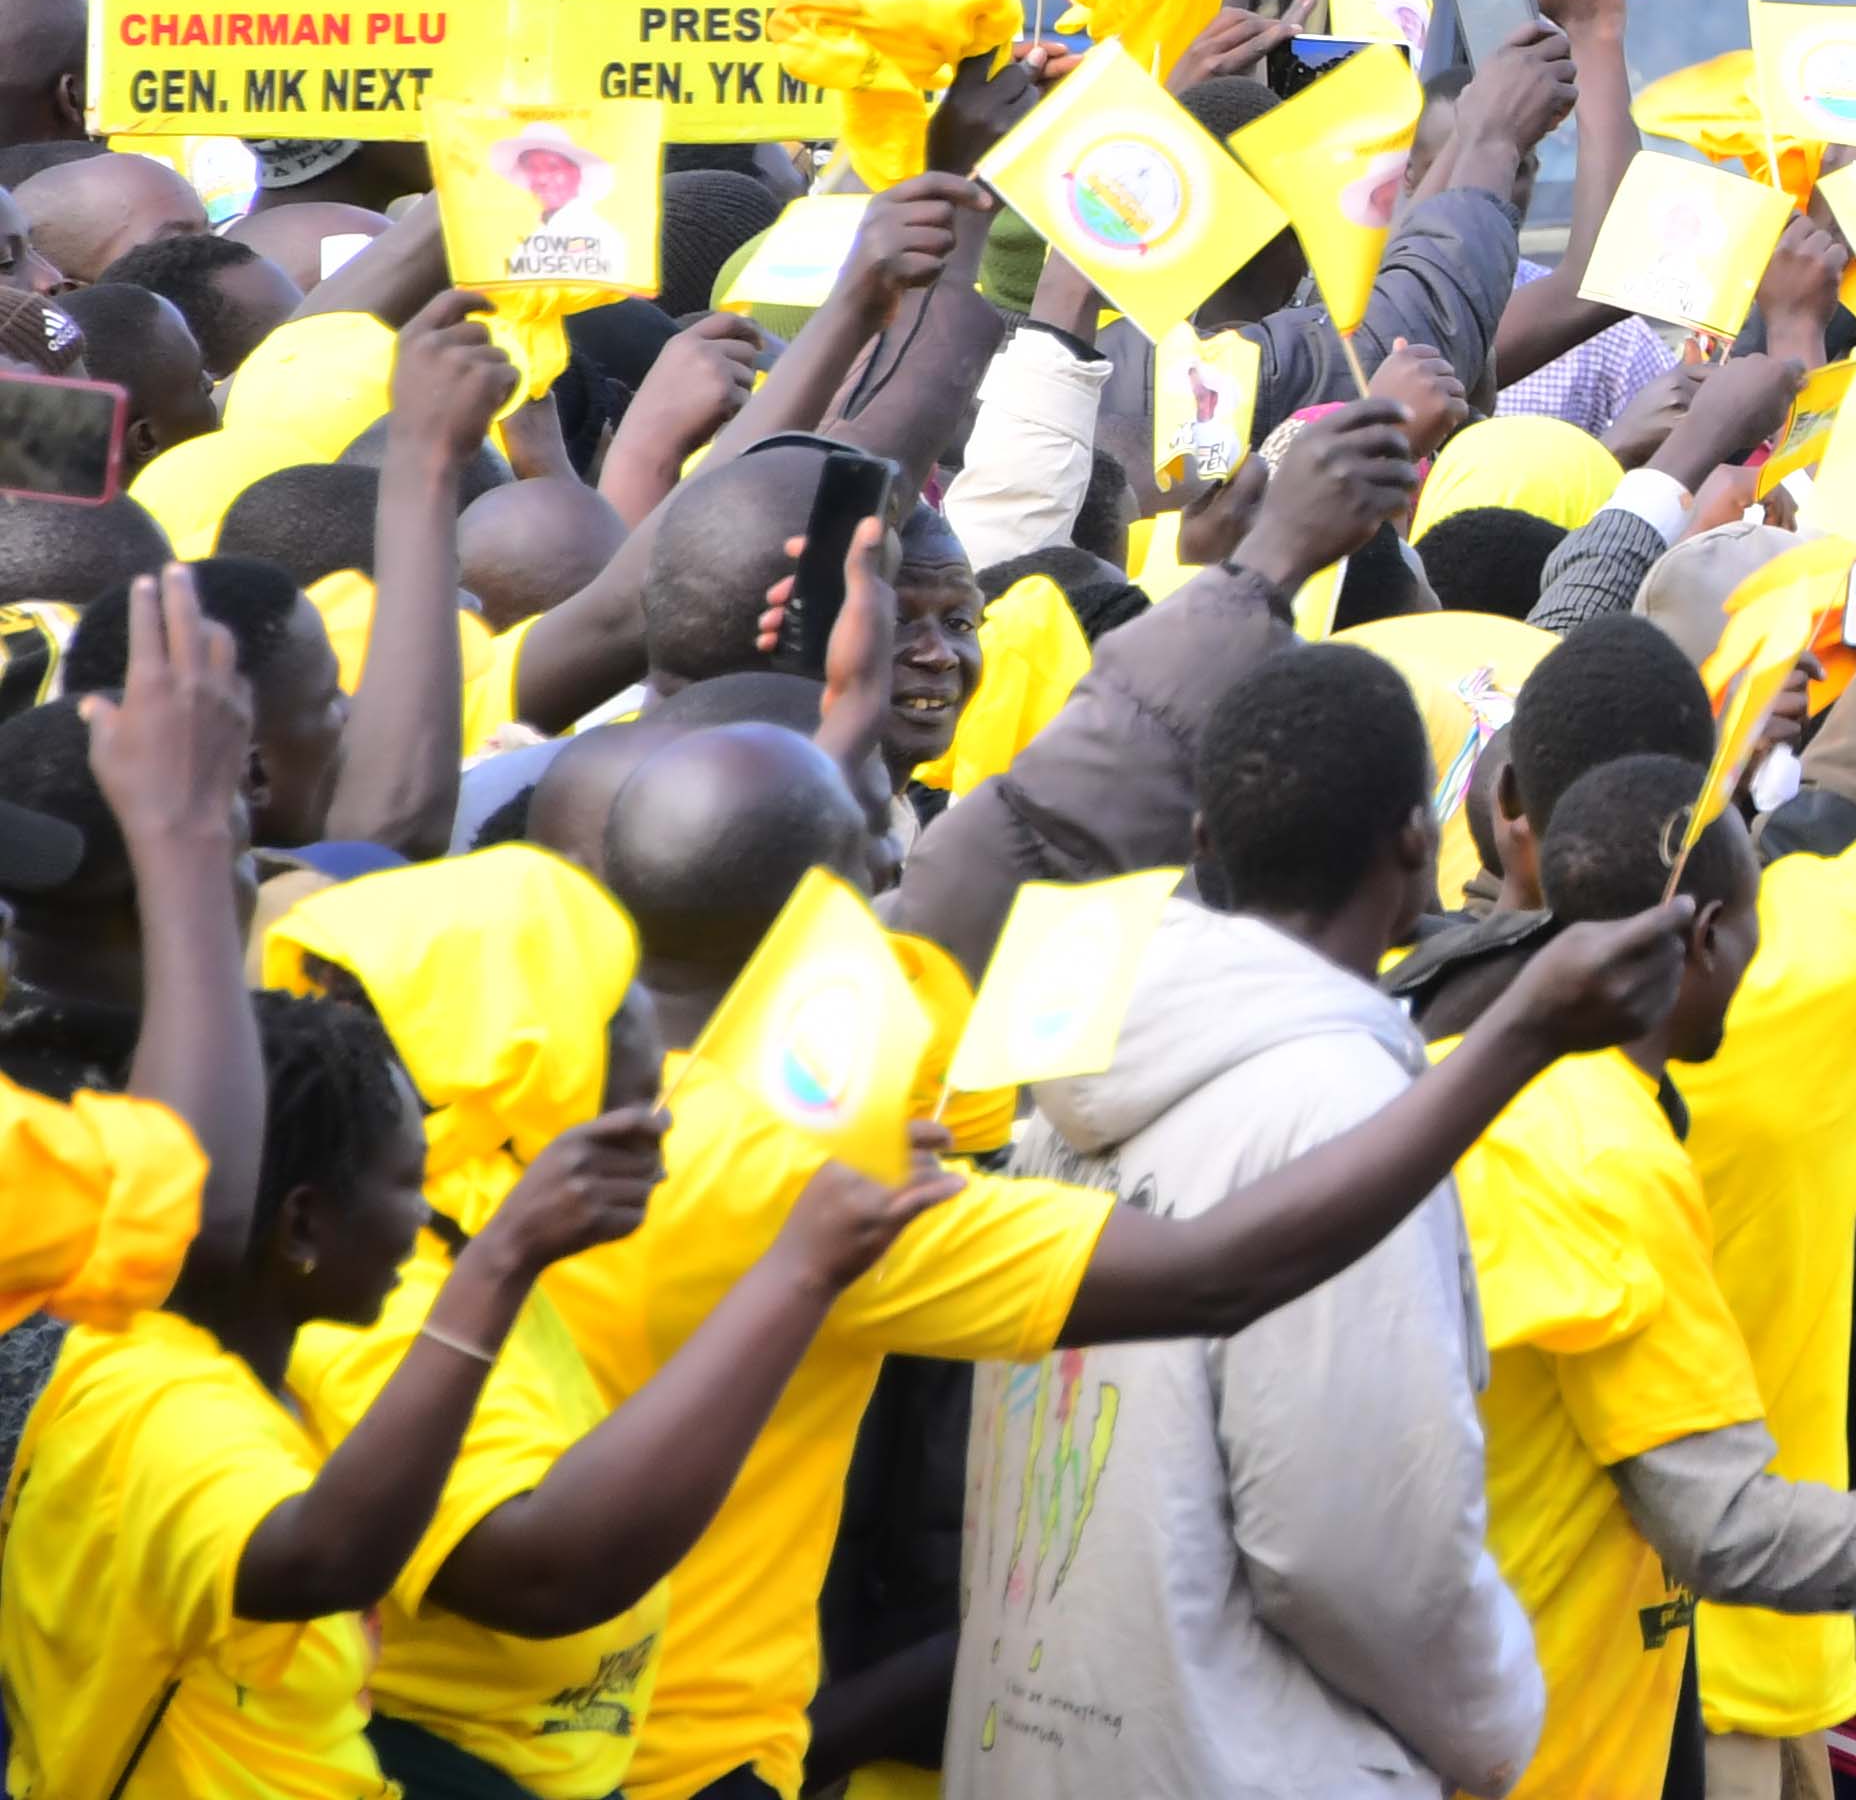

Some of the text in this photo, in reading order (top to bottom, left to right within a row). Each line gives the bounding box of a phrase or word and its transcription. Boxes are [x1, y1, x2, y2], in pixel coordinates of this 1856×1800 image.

[120, 12, 447, 46] CHAIRMAN PLU
[130, 67, 434, 114] GEN. MK NEXT
[600, 61, 694, 105] GEN.
[708, 61, 764, 104] YK
